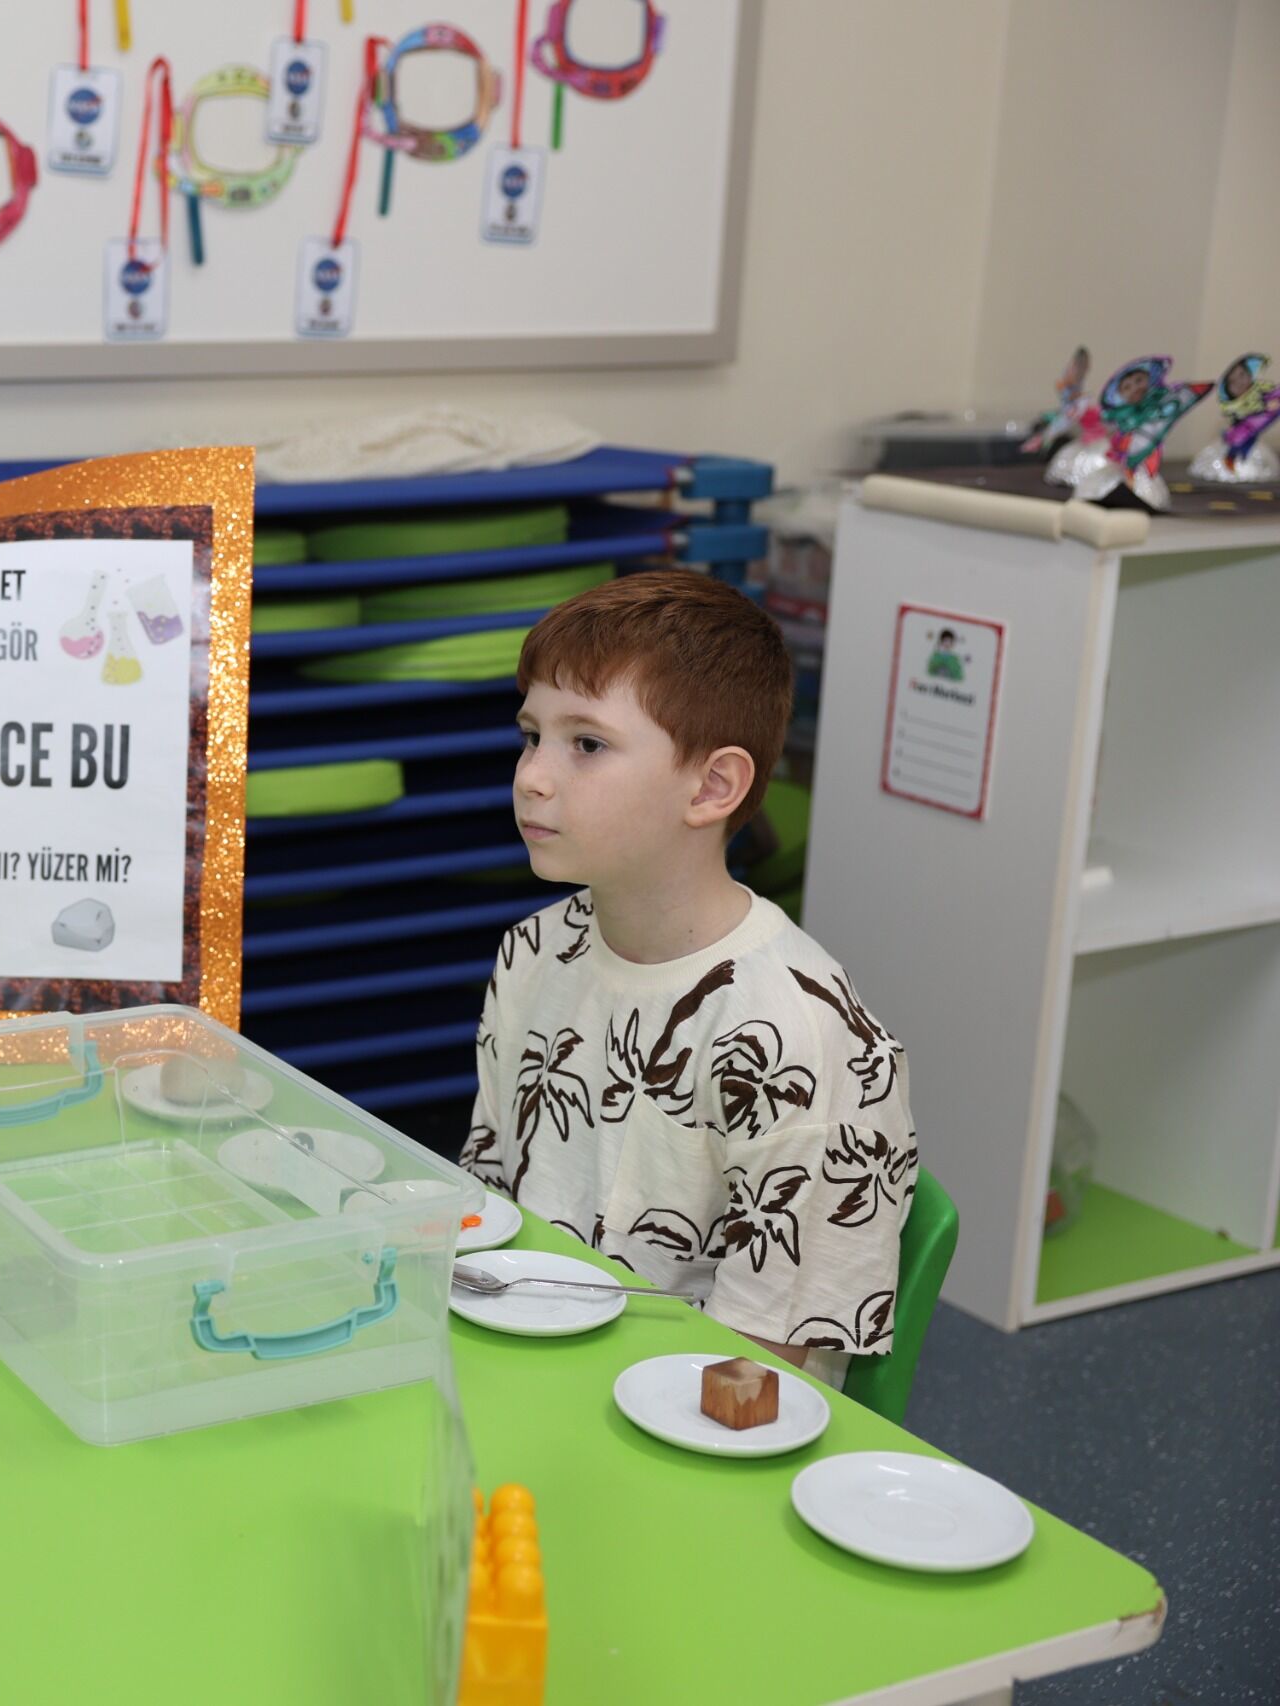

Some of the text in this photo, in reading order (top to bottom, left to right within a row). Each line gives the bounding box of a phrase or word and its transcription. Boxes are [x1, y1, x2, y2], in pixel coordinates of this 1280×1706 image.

[1, 570, 26, 601] ET
[71, 723, 130, 790] BU
[28, 847, 89, 882] YÜZER
[96, 848, 132, 883] Mİ?
